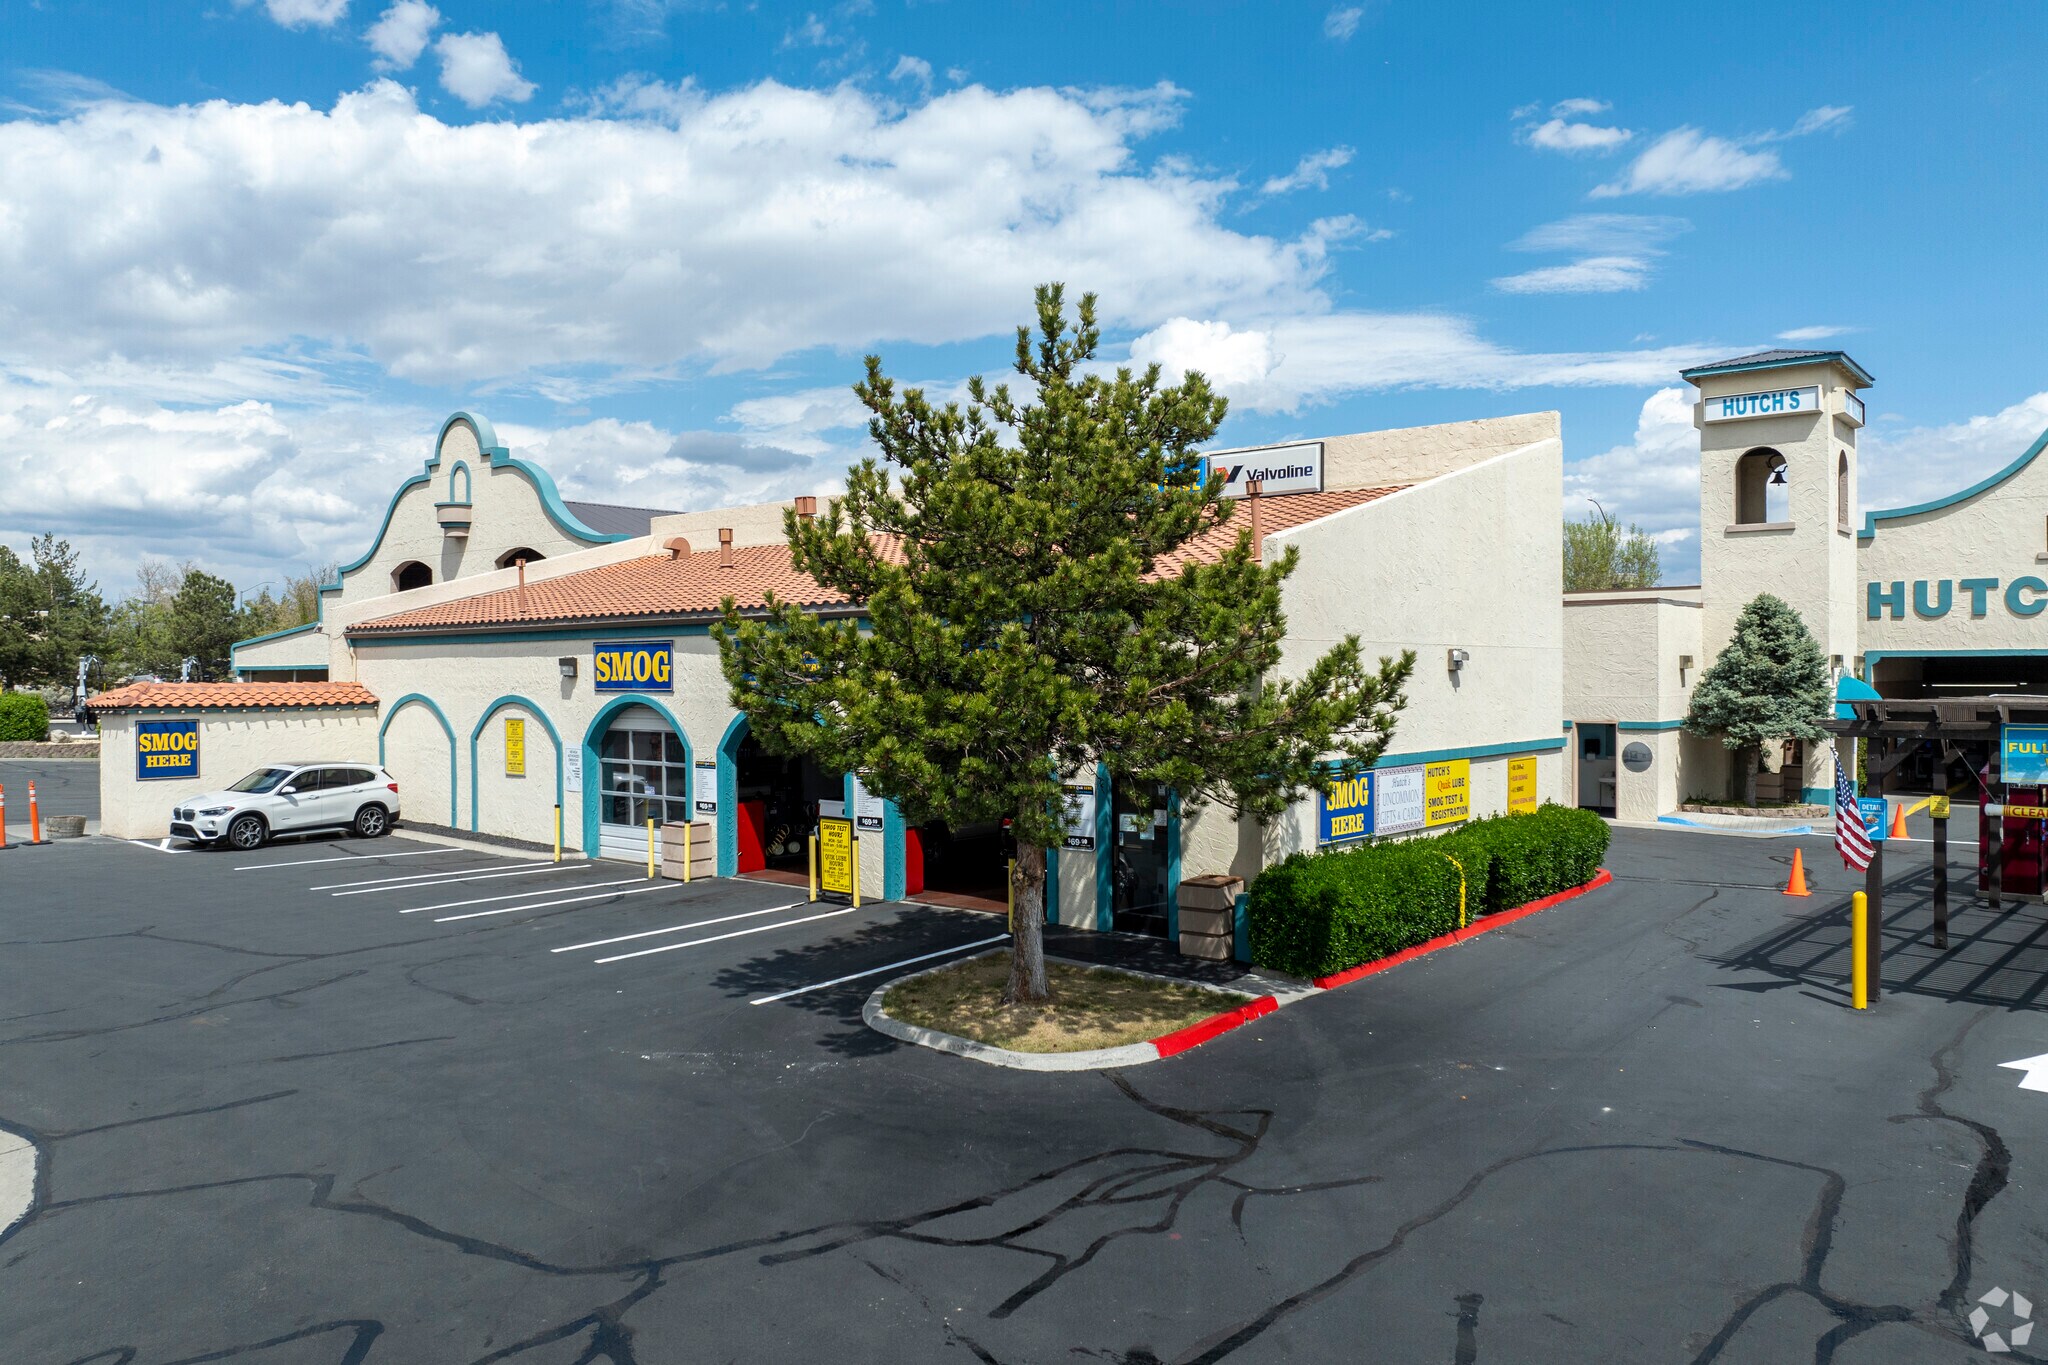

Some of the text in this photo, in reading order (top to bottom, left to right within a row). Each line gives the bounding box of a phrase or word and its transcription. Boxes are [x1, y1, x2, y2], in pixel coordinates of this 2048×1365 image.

[1723, 391, 1800, 417] HUTCH'S
[1246, 465, 1313, 481] Valvoline
[1868, 576, 2048, 618] HUTC
[596, 651, 670, 682] SMOG
[140, 732, 198, 752] SMOG
[146, 754, 191, 767] HERE
[1428, 766, 1450, 777] HUTCH'S
[1452, 778, 1465, 788] LUBE
[1327, 777, 1369, 811] SMOG
[1428, 798, 1444, 808] SMOG
[1445, 795, 1458, 805] TEST
[1431, 805, 1468, 820] REGISTRATION
[2012, 807, 2048, 818] CLEA
[1331, 813, 1364, 836] HERE
